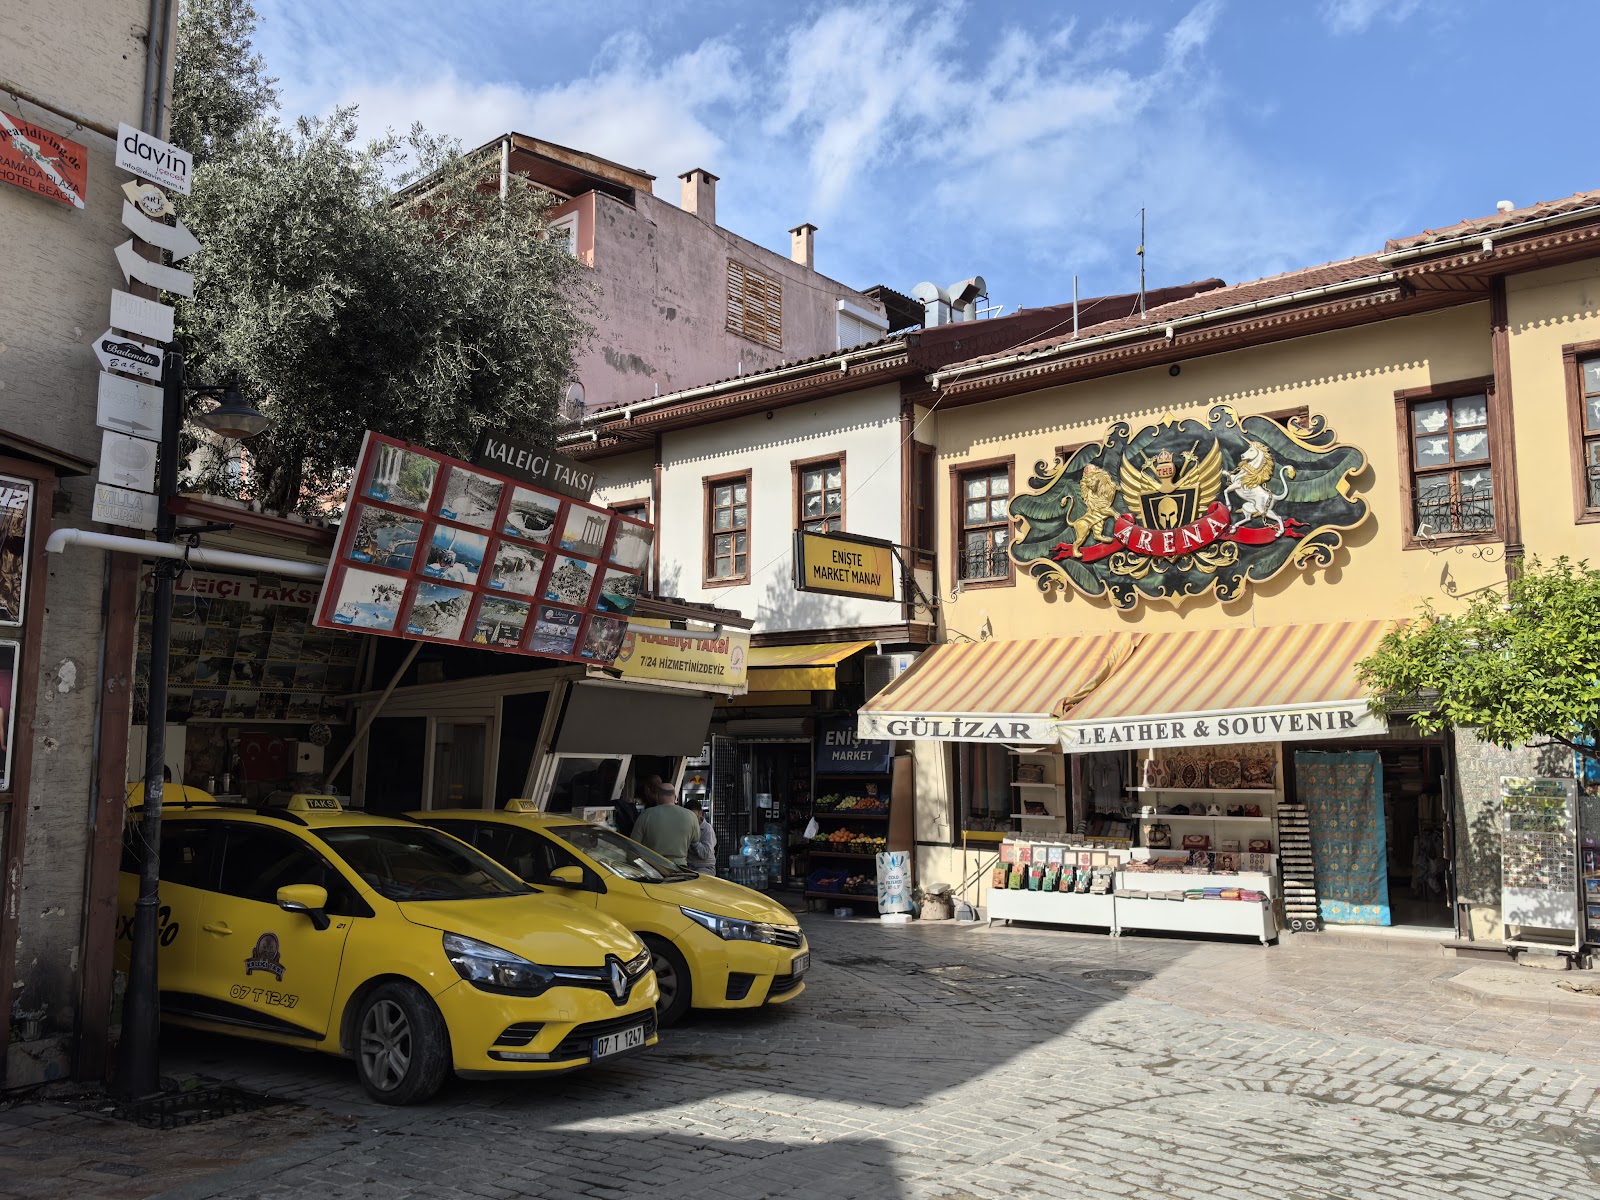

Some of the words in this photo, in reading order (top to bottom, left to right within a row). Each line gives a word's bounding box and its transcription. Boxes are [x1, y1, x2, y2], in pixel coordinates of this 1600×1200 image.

[0, 127, 81, 171] pearldiving.de
[124, 133, 186, 176] davin
[46, 173, 80, 194] PLAZA
[122, 159, 185, 191] info@davin.com.tr
[38, 182, 76, 204] BEACH
[484, 439, 550, 479] KALEİÇİ
[554, 463, 595, 493] TAKSİ
[97, 488, 144, 510] VILLA
[1114, 517, 1227, 553] ARENA
[832, 548, 863, 569] ENİŞTE
[813, 565, 850, 582] MARKET
[851, 570, 881, 587] MANAV
[696, 636, 729, 655] TAKSİ
[640, 655, 657, 667] 7/24
[886, 716, 1032, 740] GÜLİZAR
[1078, 721, 1186, 745] LEATHER
[1193, 720, 1211, 738] &
[1217, 710, 1358, 737] SOUVENIR
[832, 751, 874, 761] MARKET
[229, 984, 251, 1000] 07
[253, 988, 264, 1002] T
[266, 990, 299, 1009] 1247
[598, 1037, 610, 1055] 07
[614, 1034, 619, 1051] T
[625, 1027, 642, 1047] 1247
